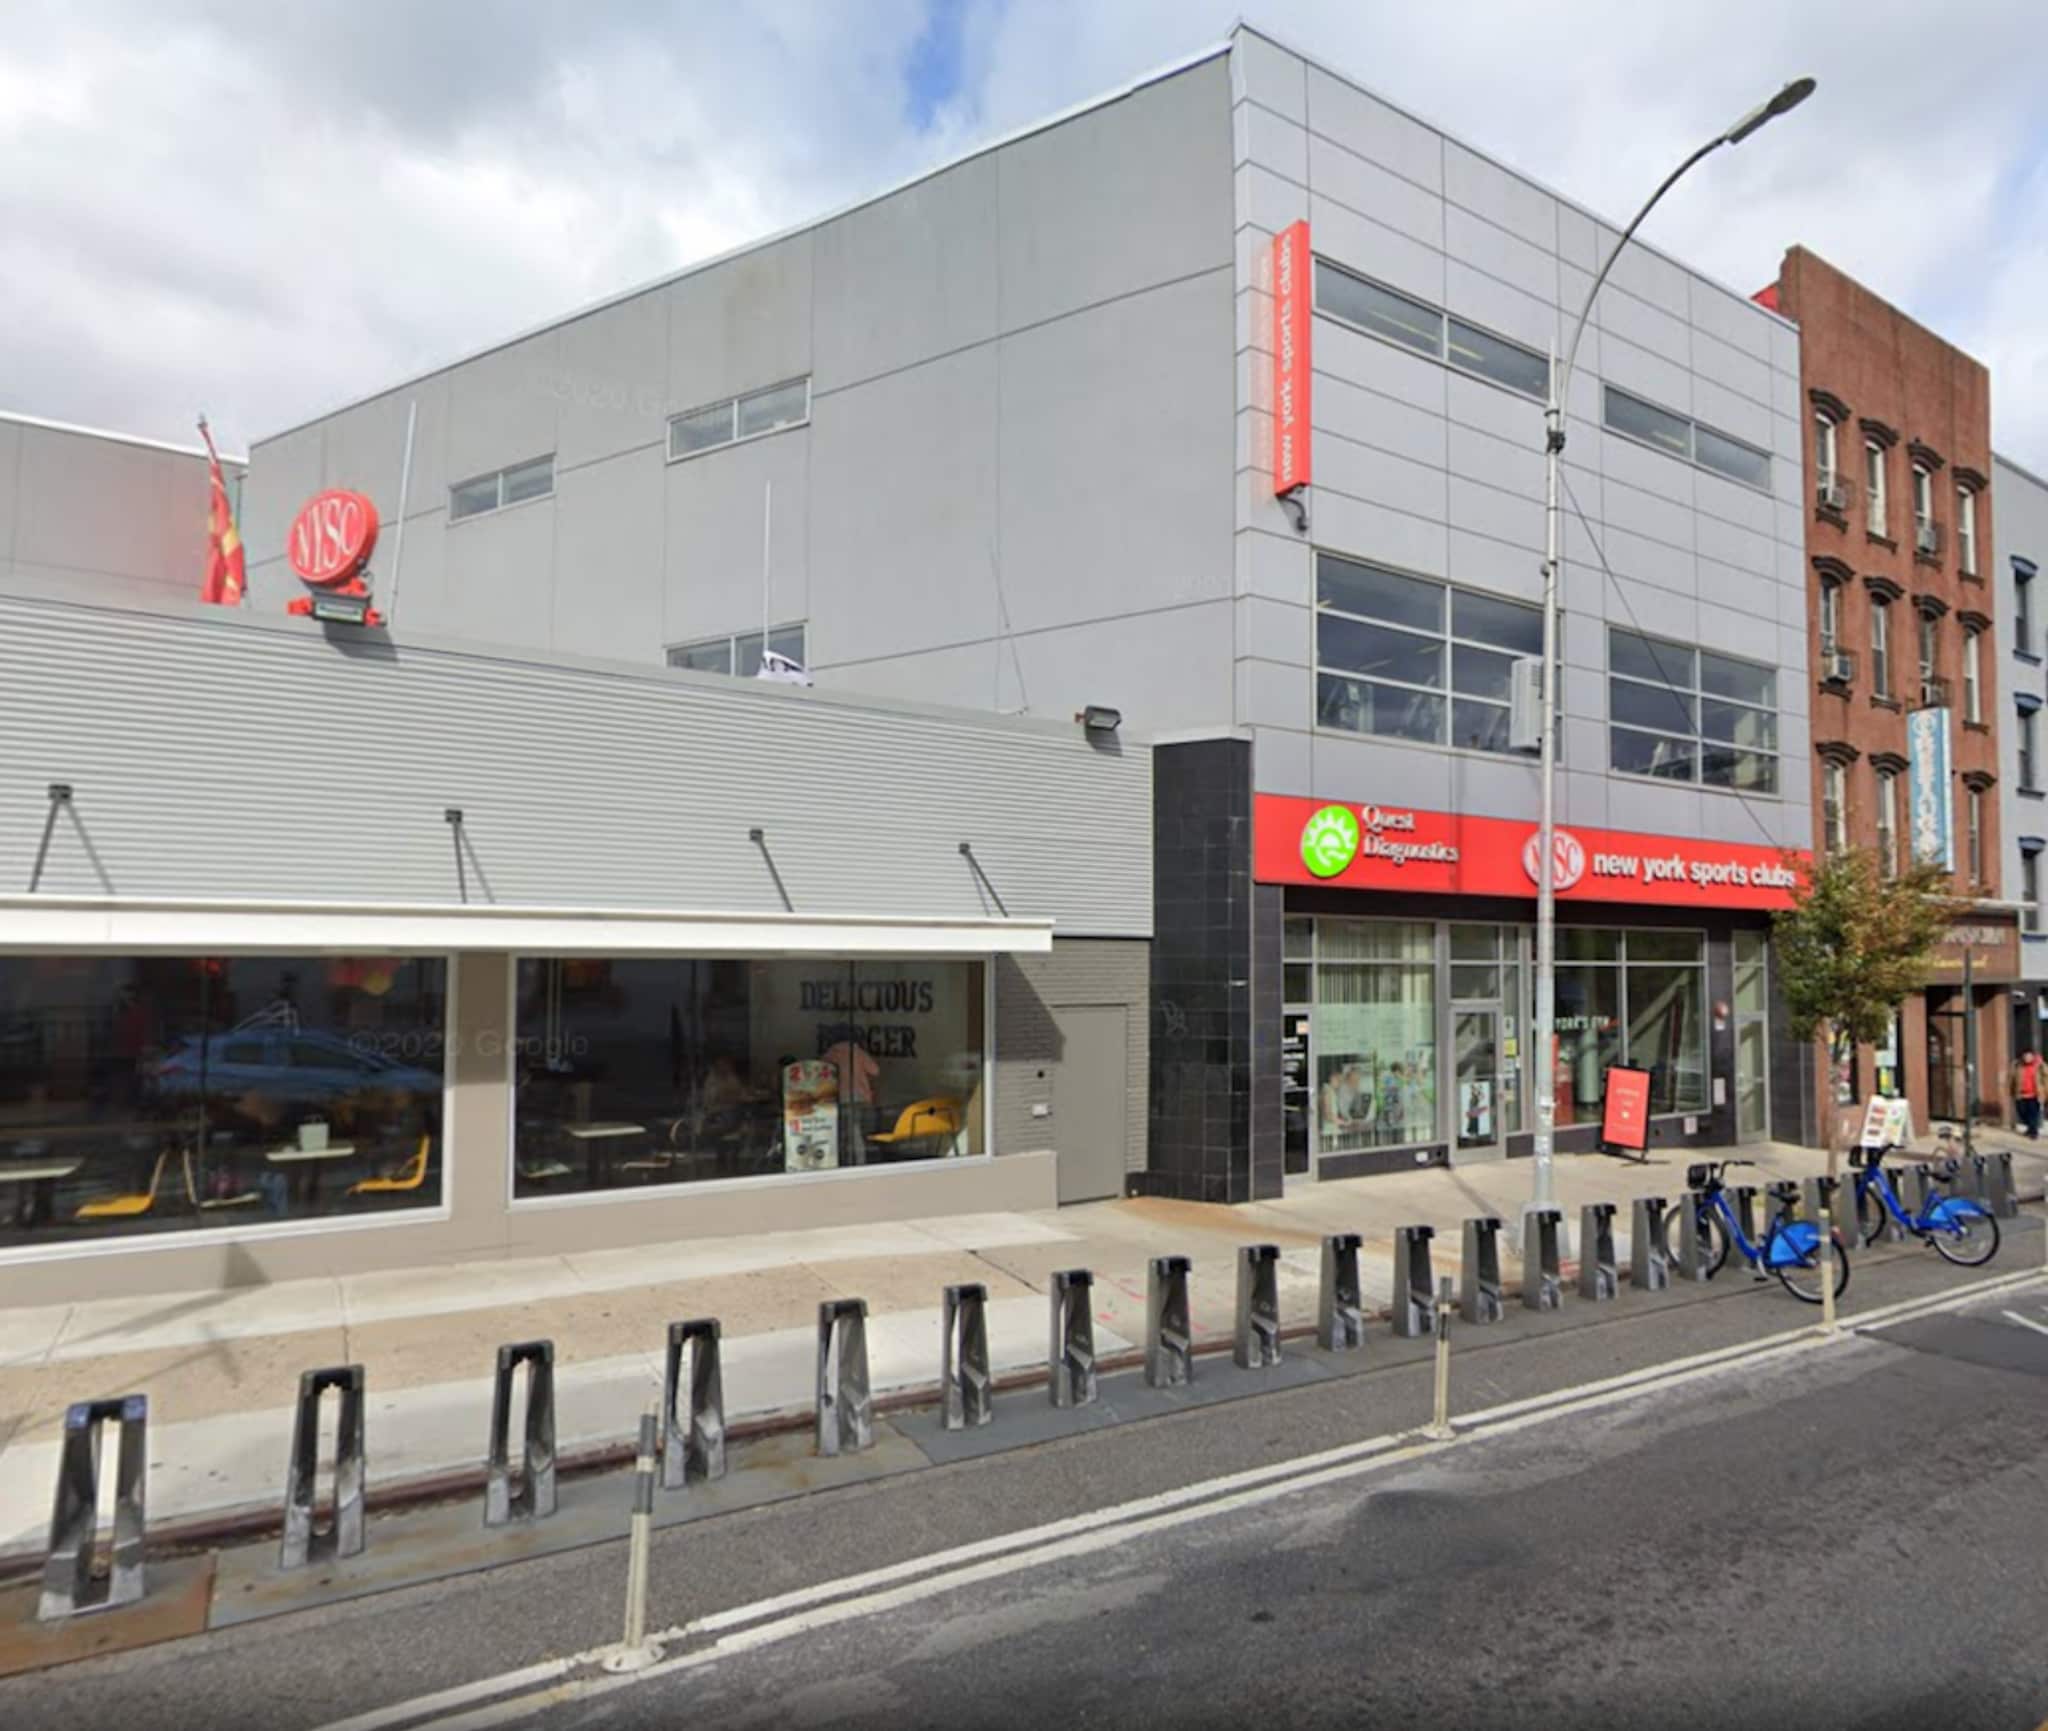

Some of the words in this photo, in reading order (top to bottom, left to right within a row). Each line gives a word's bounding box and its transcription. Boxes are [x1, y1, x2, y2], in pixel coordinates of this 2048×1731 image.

[1280, 233, 1293, 296] clubs
[1280, 299, 1294, 373] sports
[1279, 377, 1294, 429] york
[1281, 434, 1293, 482] new
[297, 498, 359, 574] NYSC
[1361, 805, 1416, 832] Quest
[1363, 834, 1460, 864] Diagnostics
[1531, 836, 1579, 882] NSC
[1593, 852, 1638, 875] new
[1642, 853, 1688, 883] york
[1689, 860, 1748, 887] sports
[1750, 861, 1795, 887] clubs
[800, 979, 934, 1013] DELICIOUS
